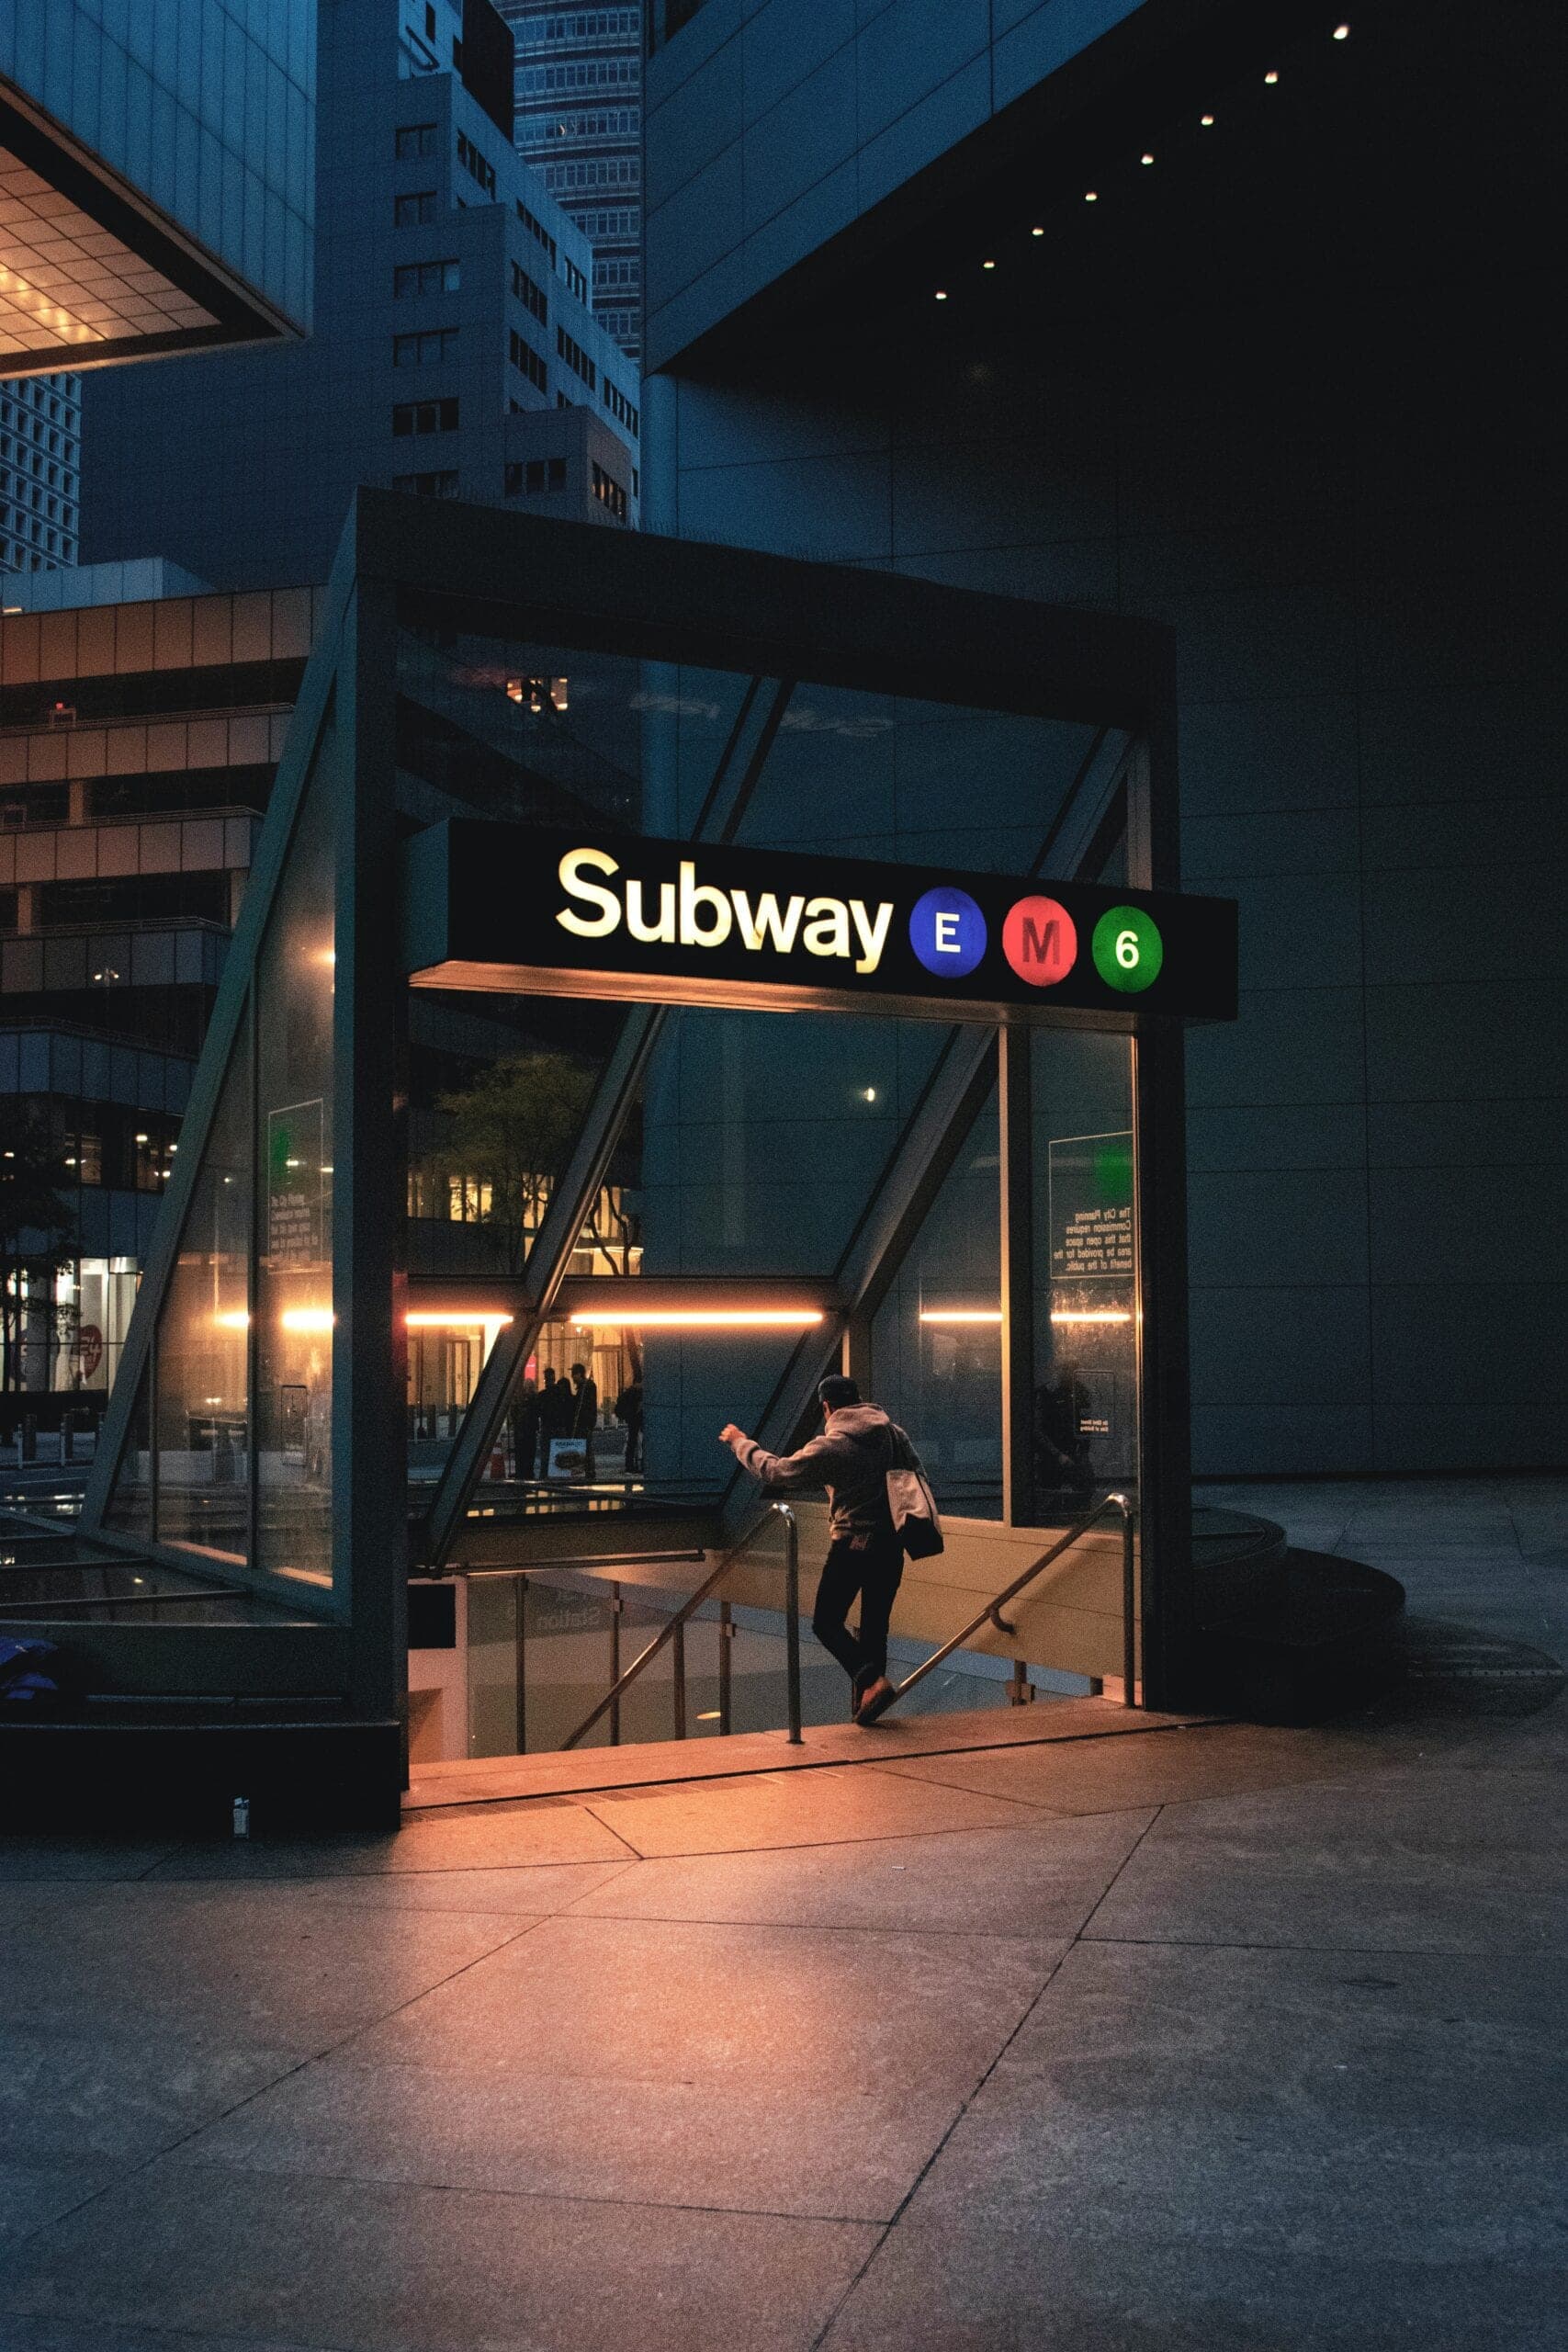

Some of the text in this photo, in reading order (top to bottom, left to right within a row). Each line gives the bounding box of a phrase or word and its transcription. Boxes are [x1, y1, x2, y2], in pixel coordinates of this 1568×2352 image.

[556, 847, 1140, 974] Subway E M 6
